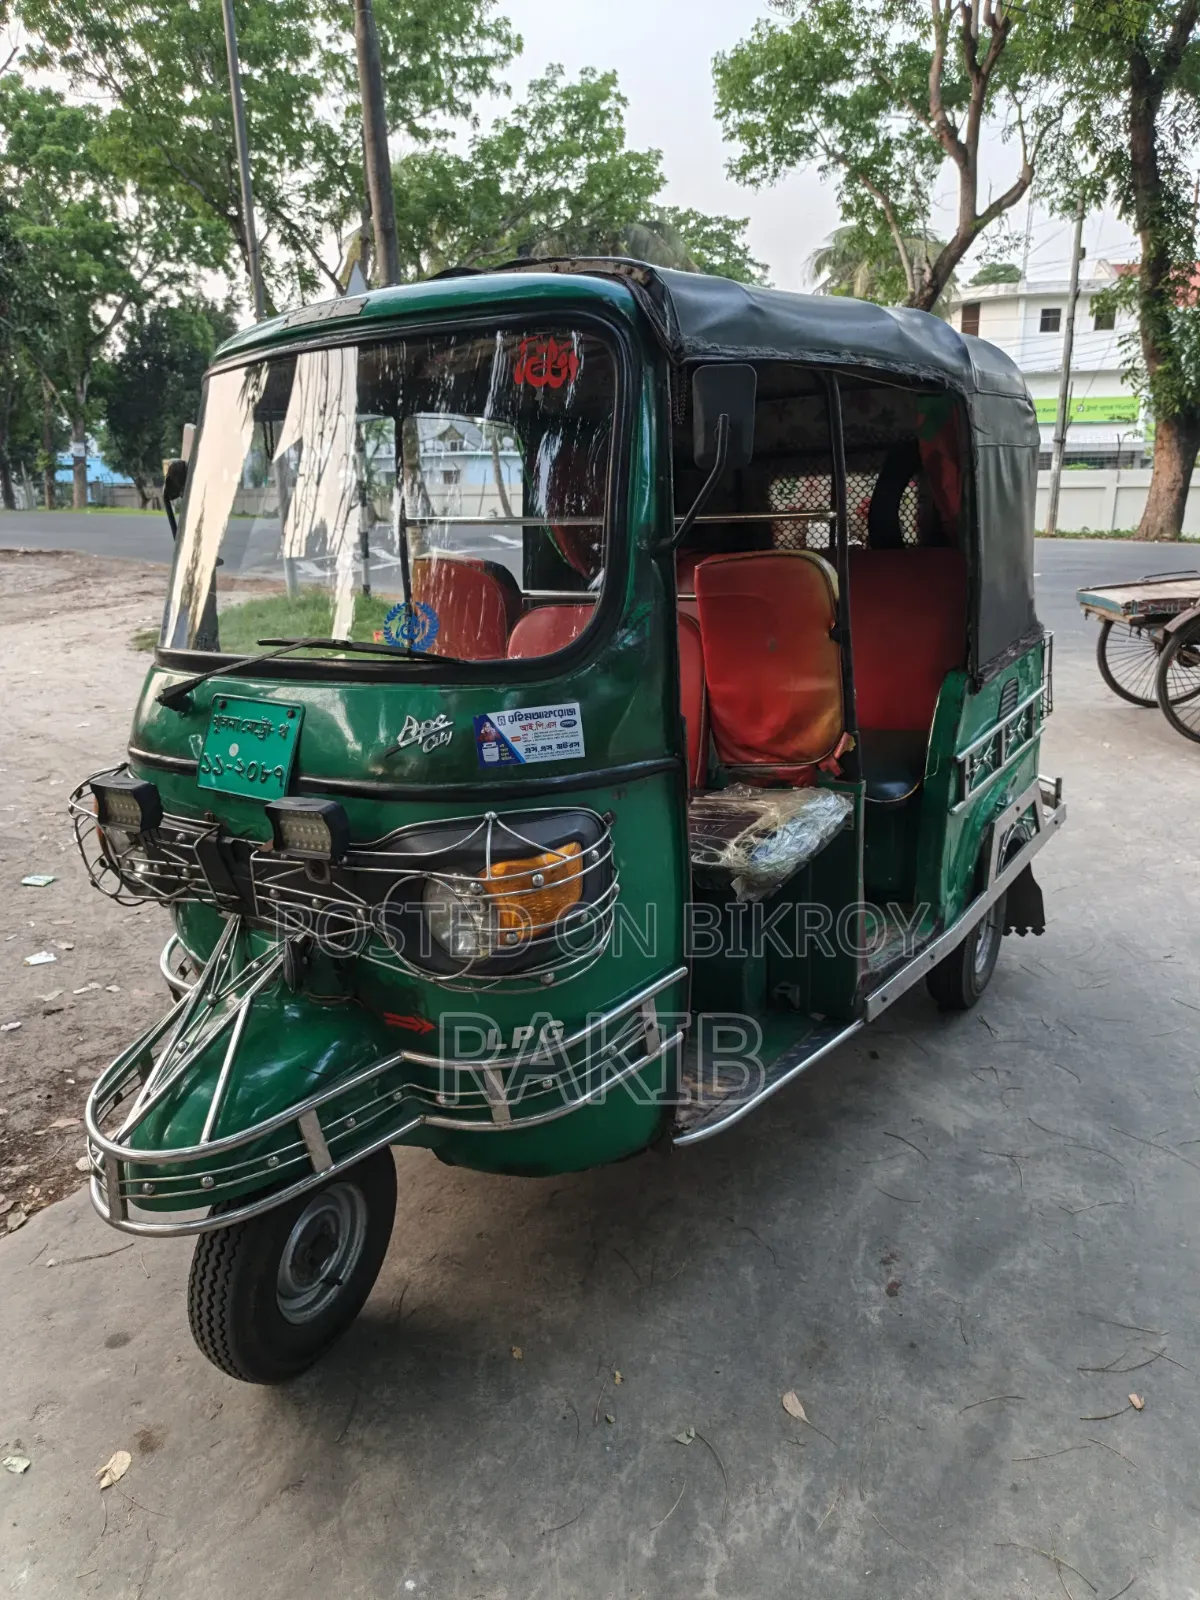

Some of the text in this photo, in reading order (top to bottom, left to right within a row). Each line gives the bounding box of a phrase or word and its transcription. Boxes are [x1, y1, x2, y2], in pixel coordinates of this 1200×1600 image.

[397, 714, 454, 748] Ape
[422, 731, 453, 754] City
[486, 1019, 565, 1052] LPG
